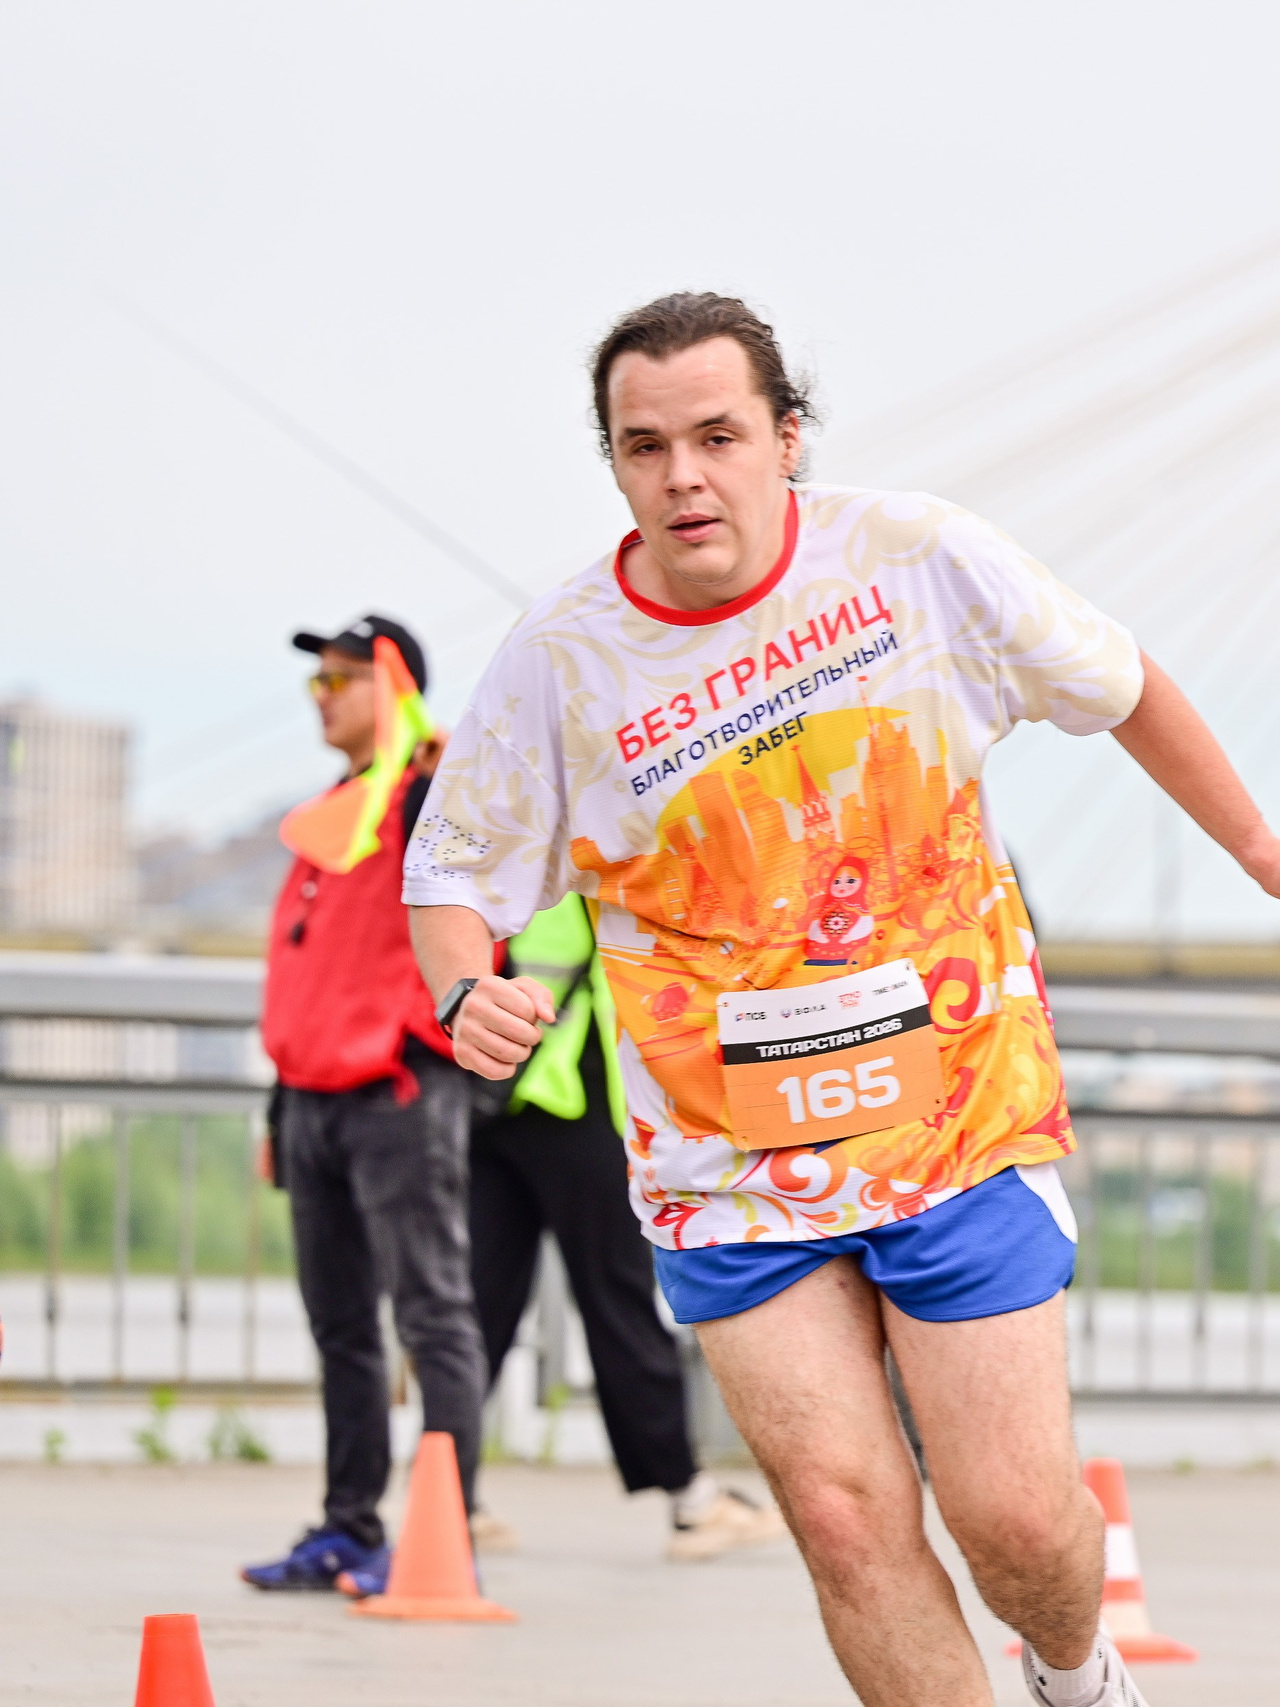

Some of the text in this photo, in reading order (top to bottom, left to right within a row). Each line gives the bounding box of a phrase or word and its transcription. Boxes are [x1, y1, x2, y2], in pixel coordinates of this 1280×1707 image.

[615, 585, 893, 763] БЕЗ ГРАНИЦ
[630, 630, 898, 796] БЛАГОТВОРИТЕЛЬНЫЙ
[738, 711, 808, 766] ЗАБЕГ
[755, 1018, 903, 1058] ТАТАРСТАН 2026
[776, 1055, 902, 1124] 165
